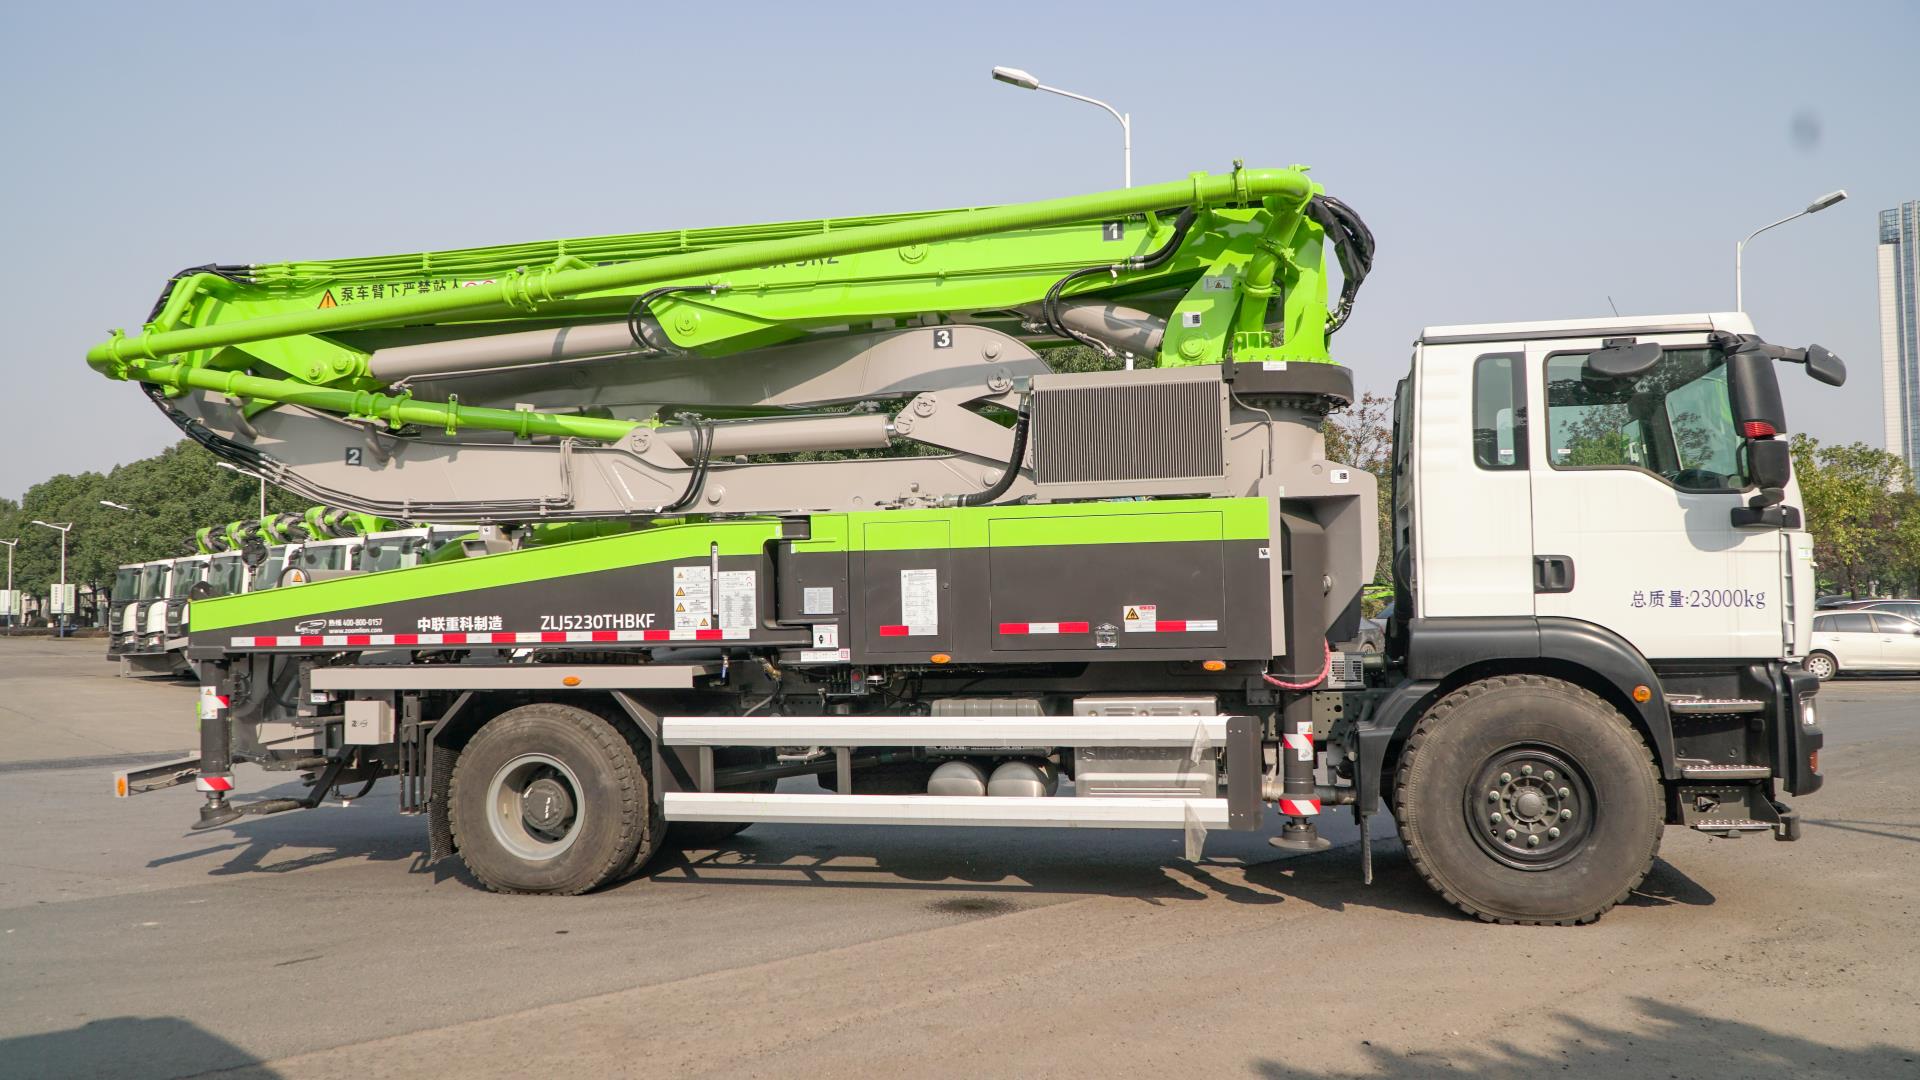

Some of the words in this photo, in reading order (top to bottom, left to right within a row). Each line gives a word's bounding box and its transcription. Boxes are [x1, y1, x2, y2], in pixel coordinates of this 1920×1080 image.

[1109, 223, 1118, 239] 1
[341, 278, 459, 301] 泵车臂下严禁站人
[937, 330, 950, 347] 3
[348, 449, 360, 465] 2
[343, 618, 383, 627] 400-800-0157
[417, 615, 503, 632] 中联重科制造
[540, 613, 656, 631] ZLJ5230THBKF
